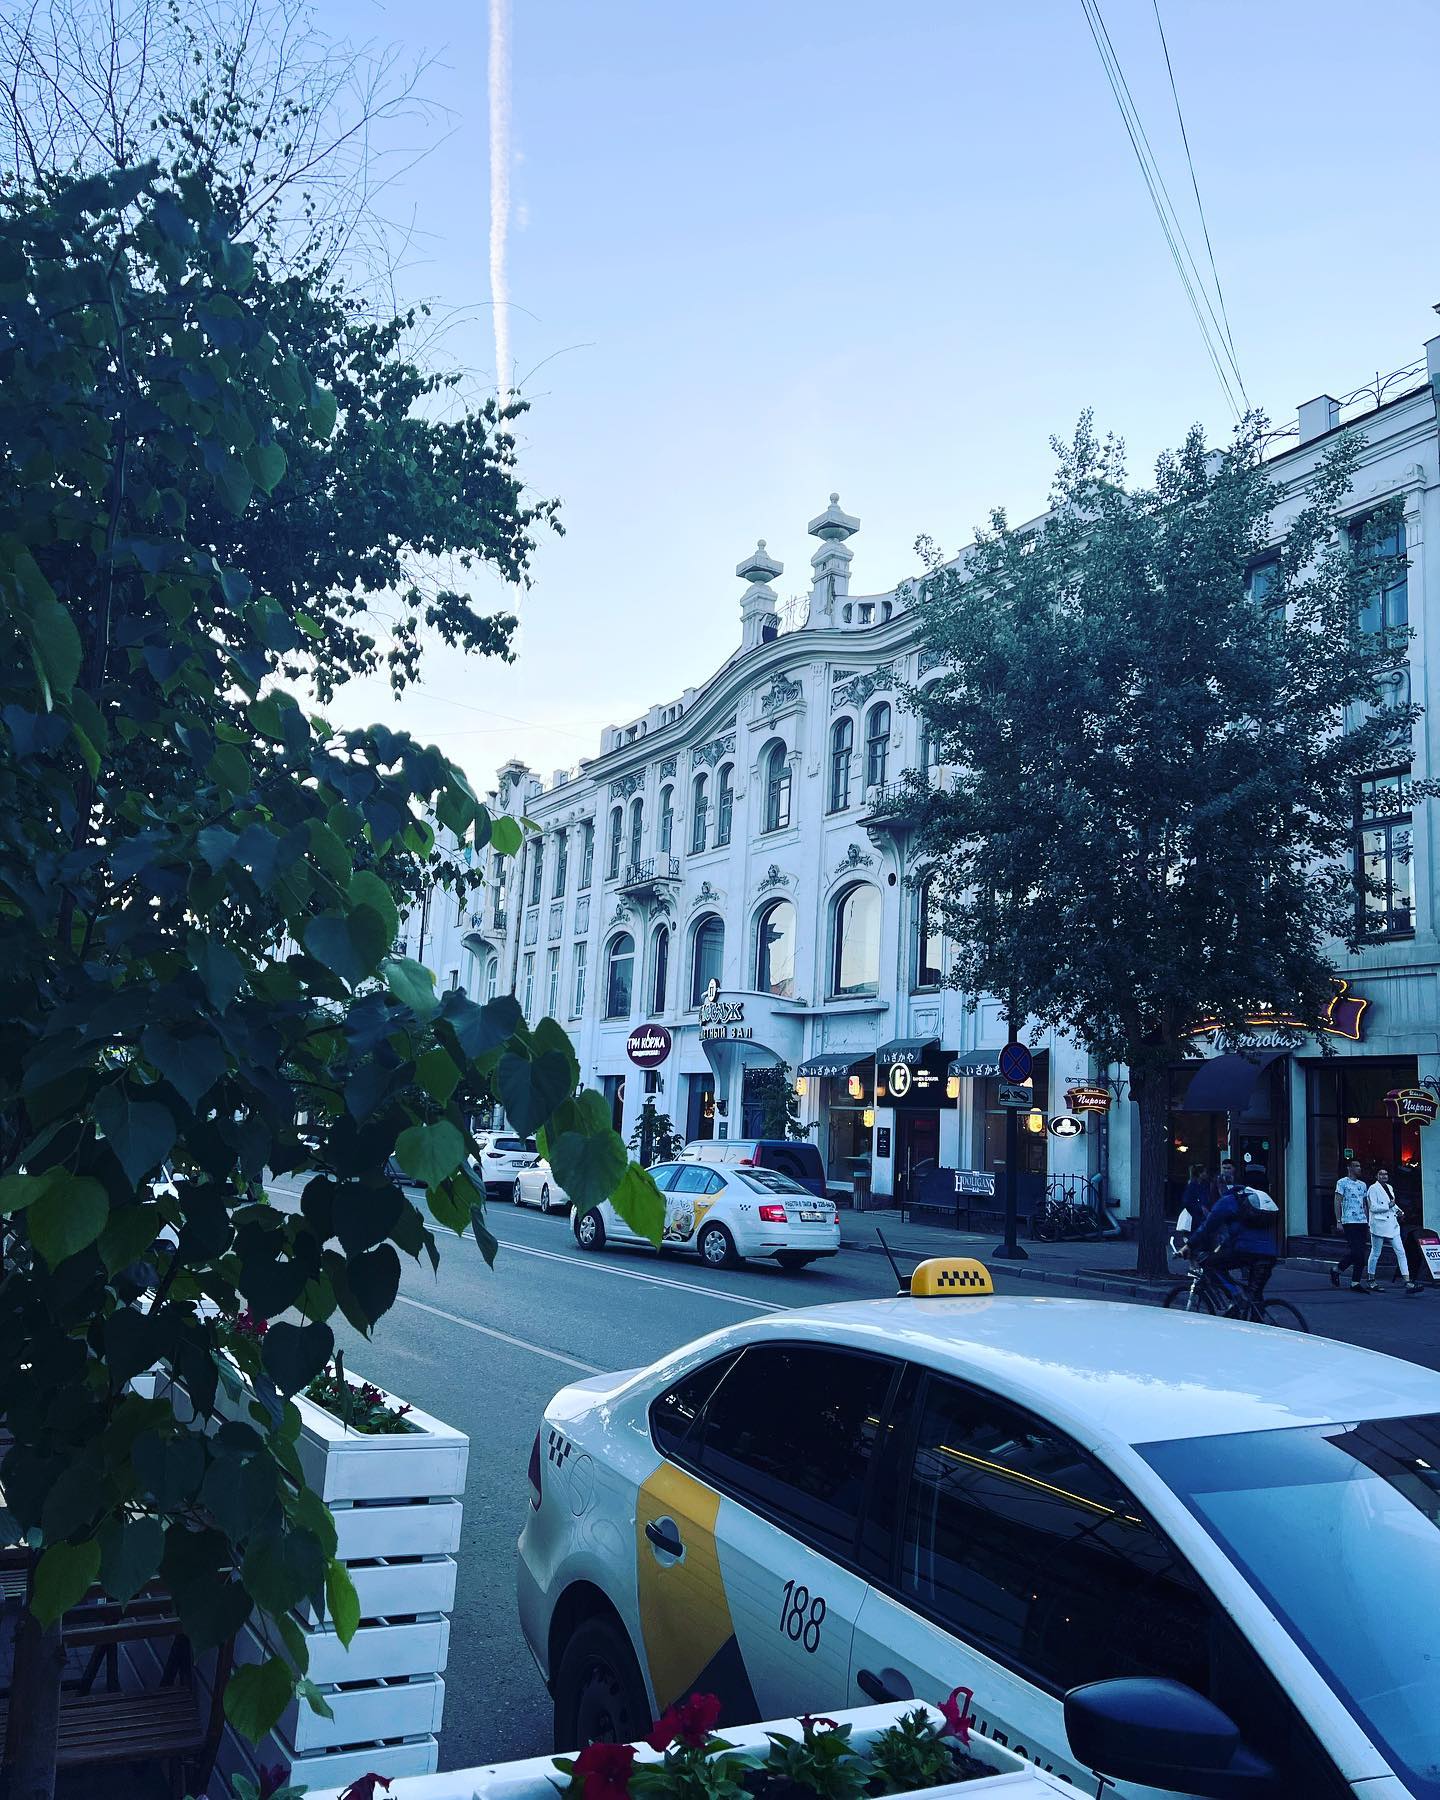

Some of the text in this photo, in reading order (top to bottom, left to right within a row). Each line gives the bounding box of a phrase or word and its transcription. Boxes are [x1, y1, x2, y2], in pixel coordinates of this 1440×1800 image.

[731, 1027, 752, 1038] ЗАЛ
[628, 1034, 665, 1049] ТРИ КОРЖА
[883, 1051, 914, 1062] いざかや
[1077, 1095, 1106, 1106] Пироги
[1402, 1099, 1432, 1112] Пироги
[955, 1175, 995, 1195] HOOLIGANS
[780, 1580, 826, 1653] 188
